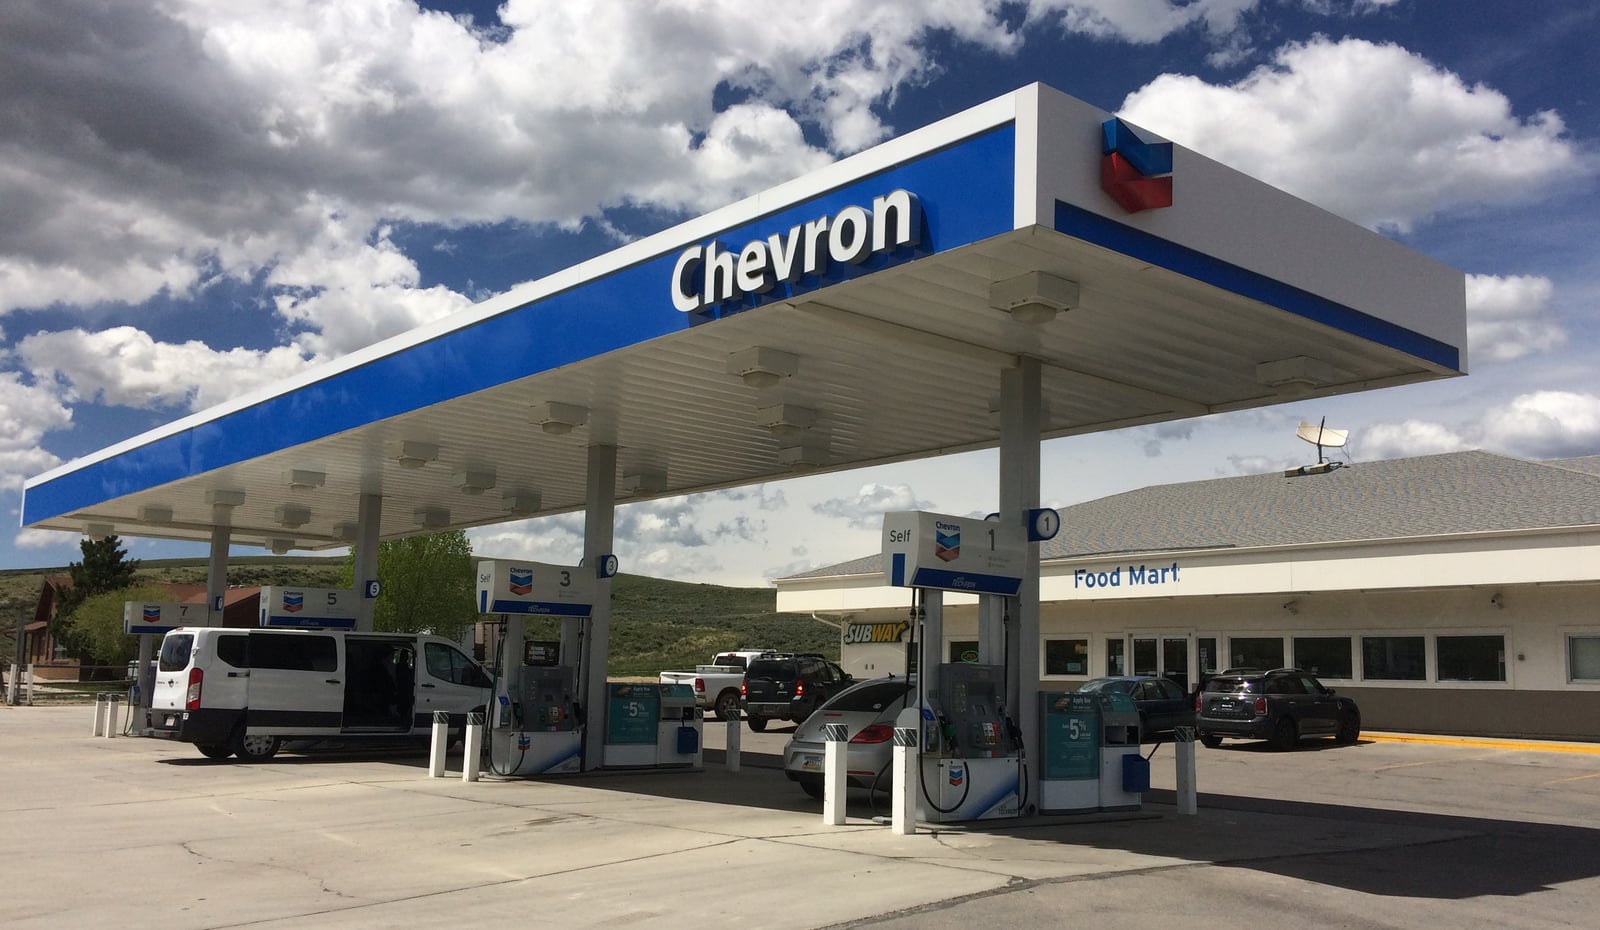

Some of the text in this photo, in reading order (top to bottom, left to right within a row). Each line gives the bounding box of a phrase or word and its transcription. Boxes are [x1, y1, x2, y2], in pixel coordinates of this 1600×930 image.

[671, 188, 914, 313] Chevron
[935, 520, 961, 532] Chevron
[1044, 516, 1050, 532] 1
[889, 529, 912, 543] Self
[988, 528, 995, 551] 1
[609, 560, 614, 571] 3
[480, 573, 491, 583] Self
[559, 570, 571, 587] 3
[1074, 562, 1178, 589] Food Mart
[371, 584, 378, 594] 5
[327, 592, 337, 606] 5
[179, 606, 189, 617] 7
[843, 621, 908, 644] SUBWAY
[1069, 718, 1087, 740] 5%
